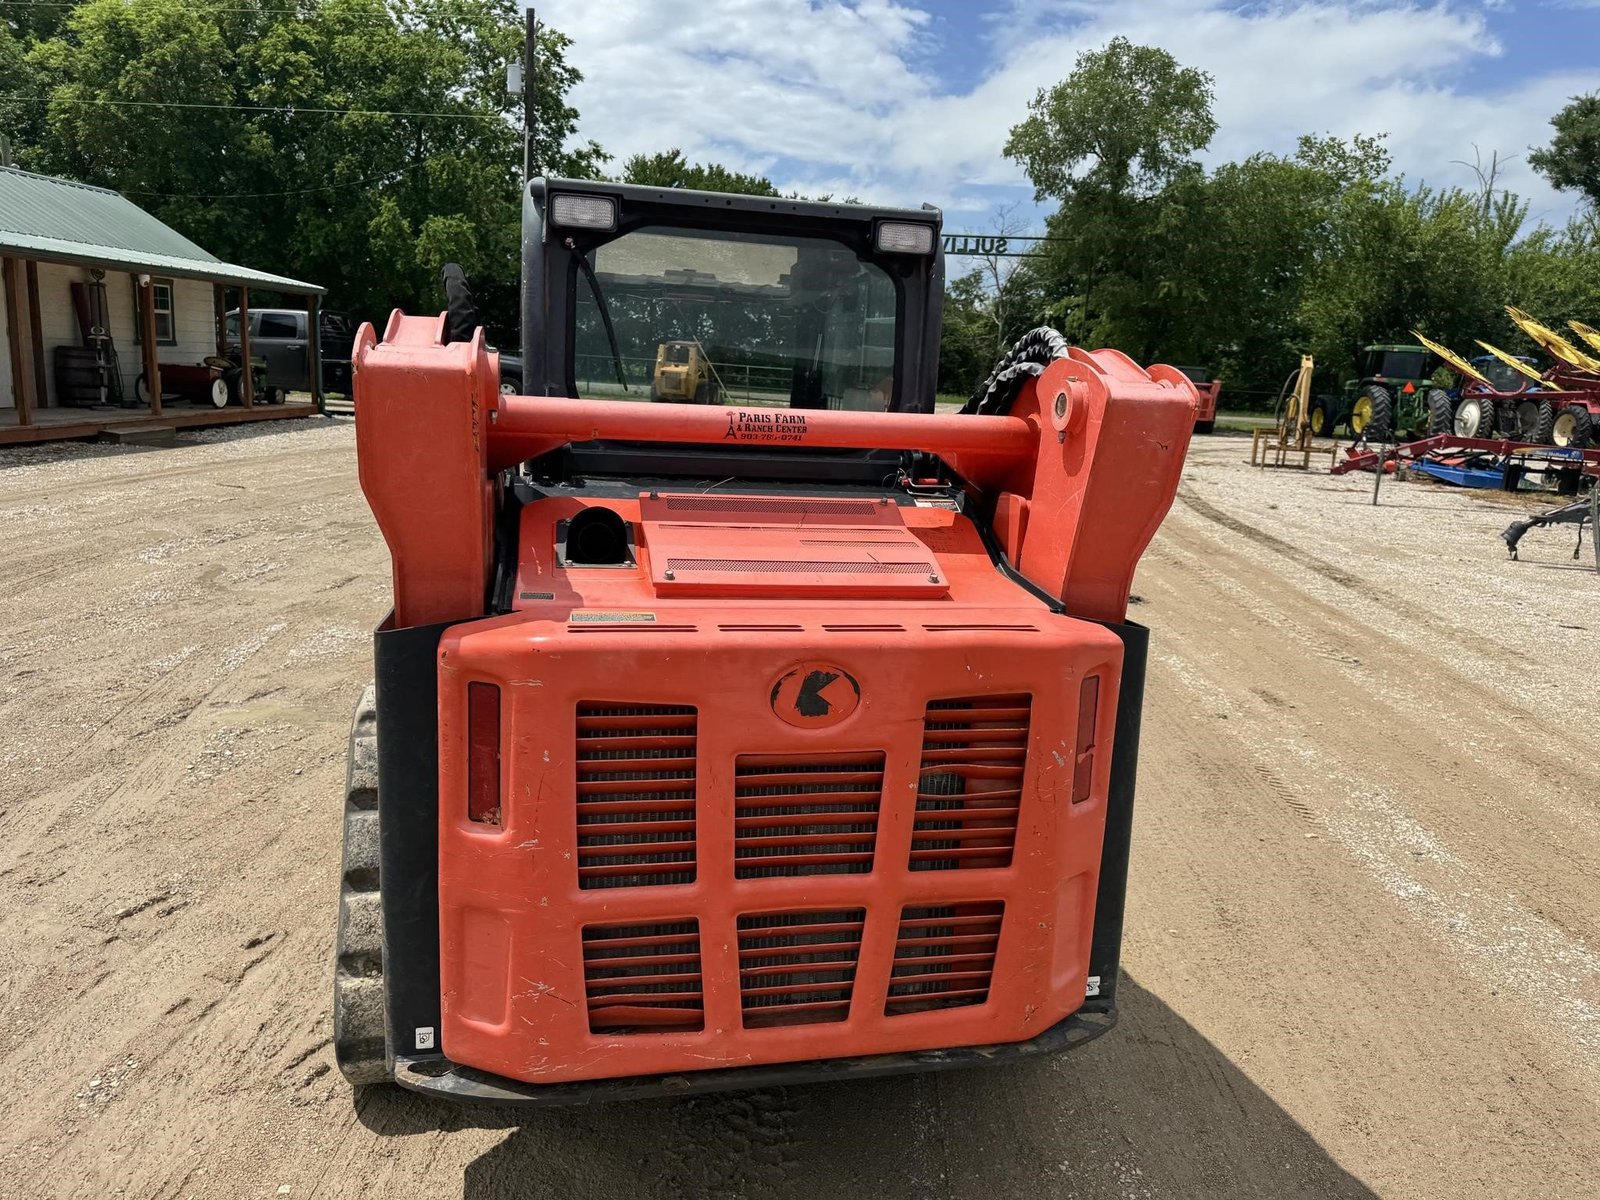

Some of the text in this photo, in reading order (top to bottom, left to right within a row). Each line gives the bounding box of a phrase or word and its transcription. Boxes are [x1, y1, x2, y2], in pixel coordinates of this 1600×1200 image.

[739, 412, 806, 424] PARIS FARM
[736, 423, 808, 434] & RANCH CENTER
